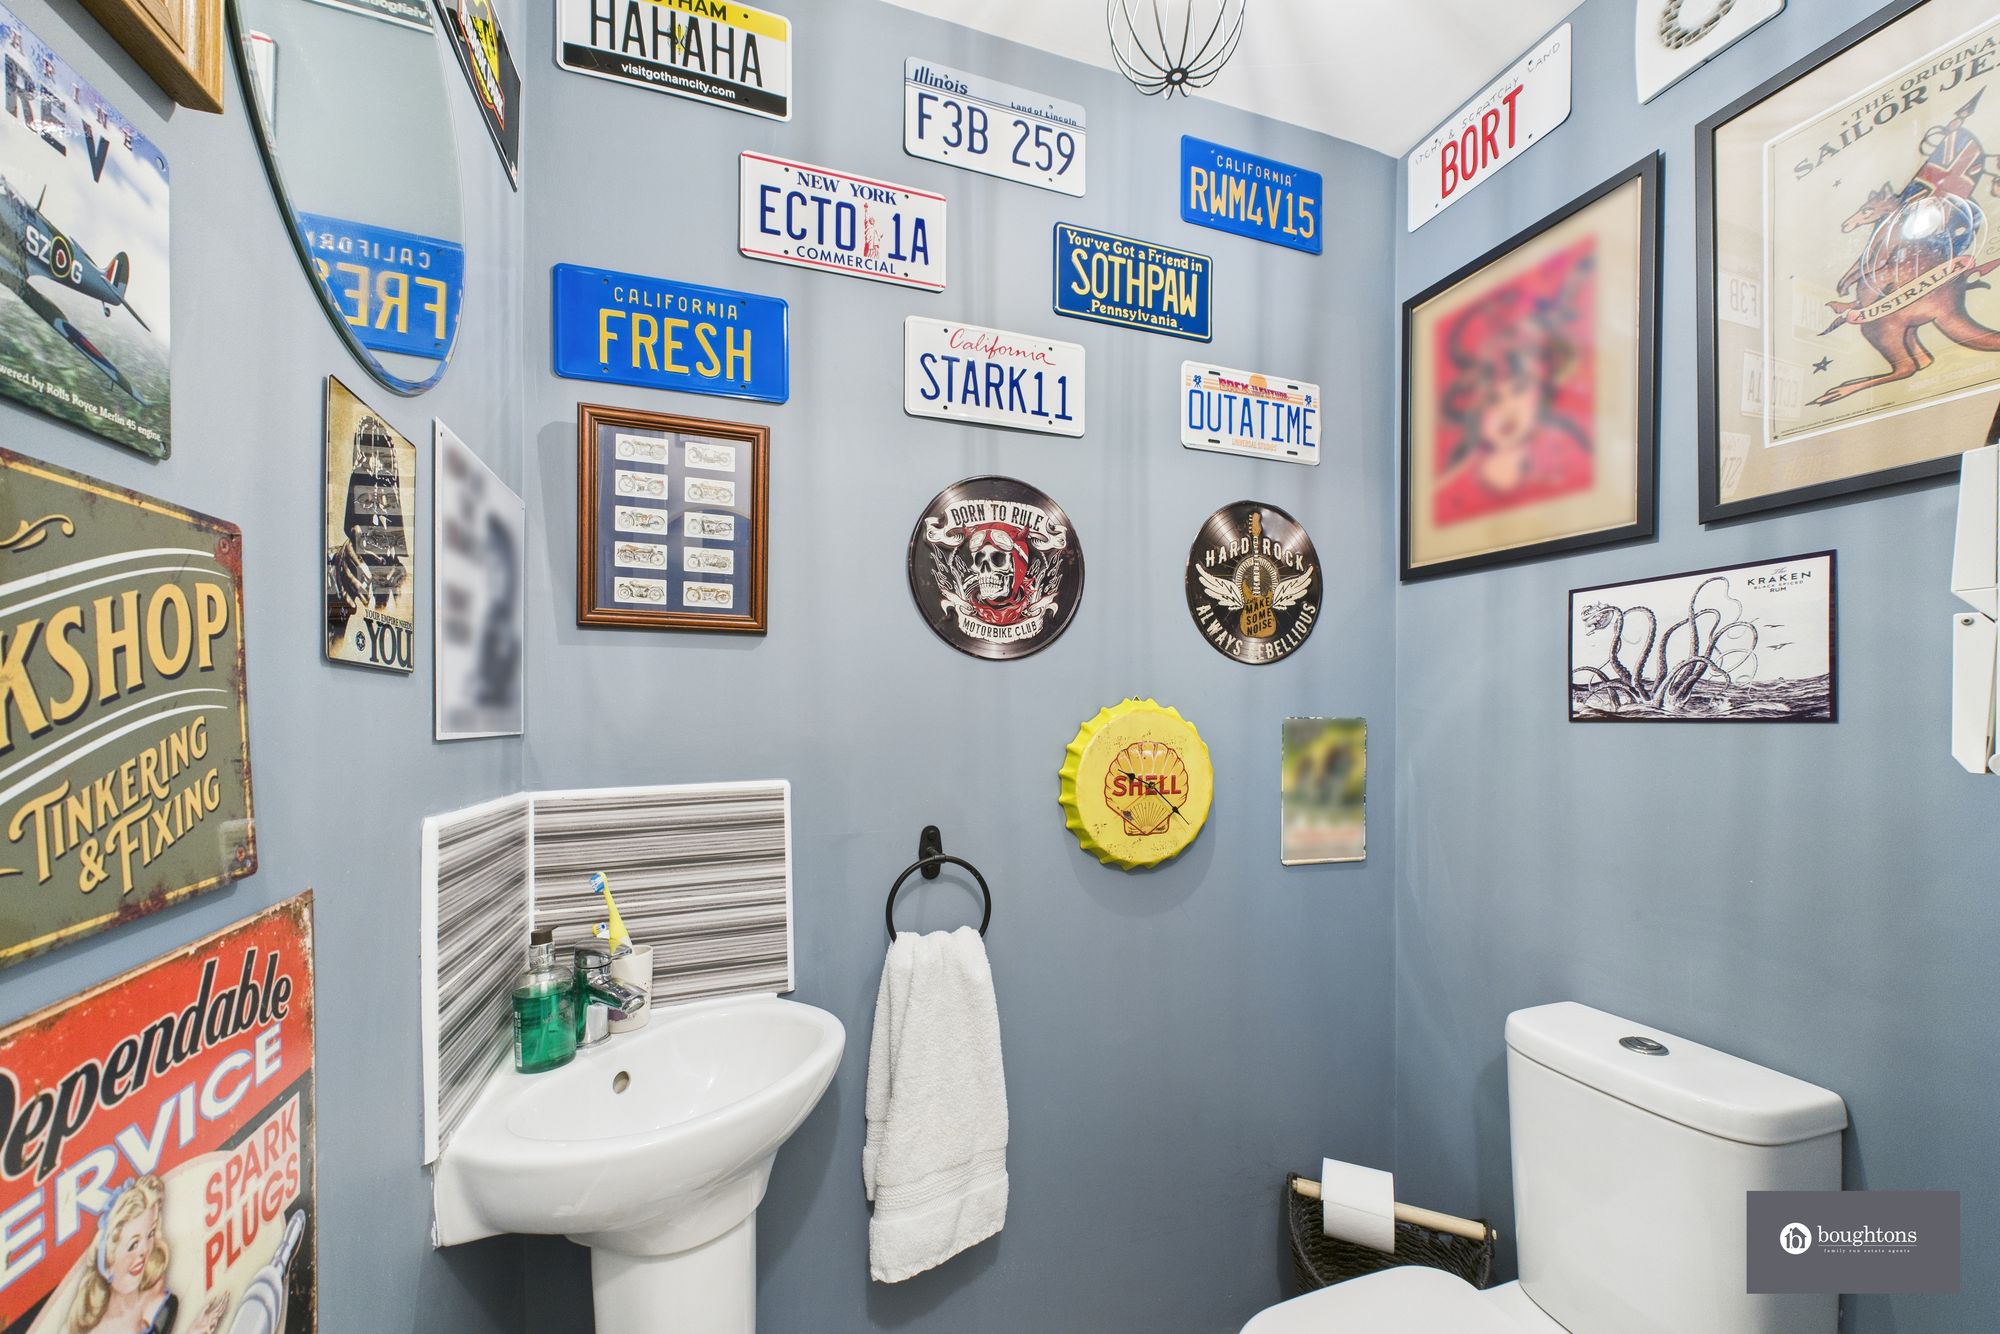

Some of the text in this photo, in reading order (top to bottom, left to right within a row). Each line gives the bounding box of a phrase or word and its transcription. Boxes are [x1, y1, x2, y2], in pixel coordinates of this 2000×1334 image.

[590, 0, 763, 88] HAHAHA
[621, 62, 736, 99] visitgothamcity.com
[914, 66, 968, 95] Illinois
[1852, 36, 2000, 121] THE ORIGINA
[918, 92, 1075, 175] F3B 259
[1011, 101, 1077, 127] Land of Lincoln
[1415, 139, 1443, 167] ITCHY
[1448, 129, 1455, 140] &
[1462, 76, 1519, 130] SCRATCHY
[1442, 84, 1525, 200] BORT
[1794, 50, 2000, 181] SAILOR JE
[797, 172, 898, 206] NEW YORK
[1217, 155, 1291, 187] CALIFORNIA
[760, 184, 929, 265] ECTO 1A
[1191, 166, 1314, 238] RWM4V15
[26, 225, 82, 284] SZ G
[796, 246, 896, 274] COMMERCIAL
[1067, 230, 1203, 273] You've Got a Friend in
[614, 286, 738, 321] CALIFORNIA
[1071, 248, 1198, 318] SOTHPAW
[1853, 260, 1966, 321] AUSTRALIA
[1091, 299, 1178, 328] Pennsylvania
[599, 308, 752, 383] FRESH
[949, 328, 1057, 366] California
[31, 375, 45, 393] by
[46, 382, 70, 402] Rolls
[72, 393, 98, 414] Royce
[100, 406, 125, 426] Merlin
[126, 419, 137, 431] 45
[920, 352, 1073, 421] STARK11
[1189, 389, 1316, 447] OUTATIME
[951, 503, 1044, 532] BORN TO RULE
[1206, 536, 1305, 572] HARD ROCK
[1747, 571, 1811, 586] KRAKEN
[363, 617, 413, 669] YOU
[365, 609, 380, 621] YOUR
[962, 618, 1038, 638] MOTORBIKE CLUB
[1196, 604, 1243, 656] ALWAYS
[1246, 596, 1273, 637] MAKE SOME NOISE
[0, 582, 229, 750] KSHOP
[9, 716, 209, 885] TINKERING
[1112, 774, 1182, 797] SHELL
[79, 768, 222, 896] & FIXING
[205, 1099, 298, 1229] SPARK
[205, 1151, 299, 1292] PLUGS
